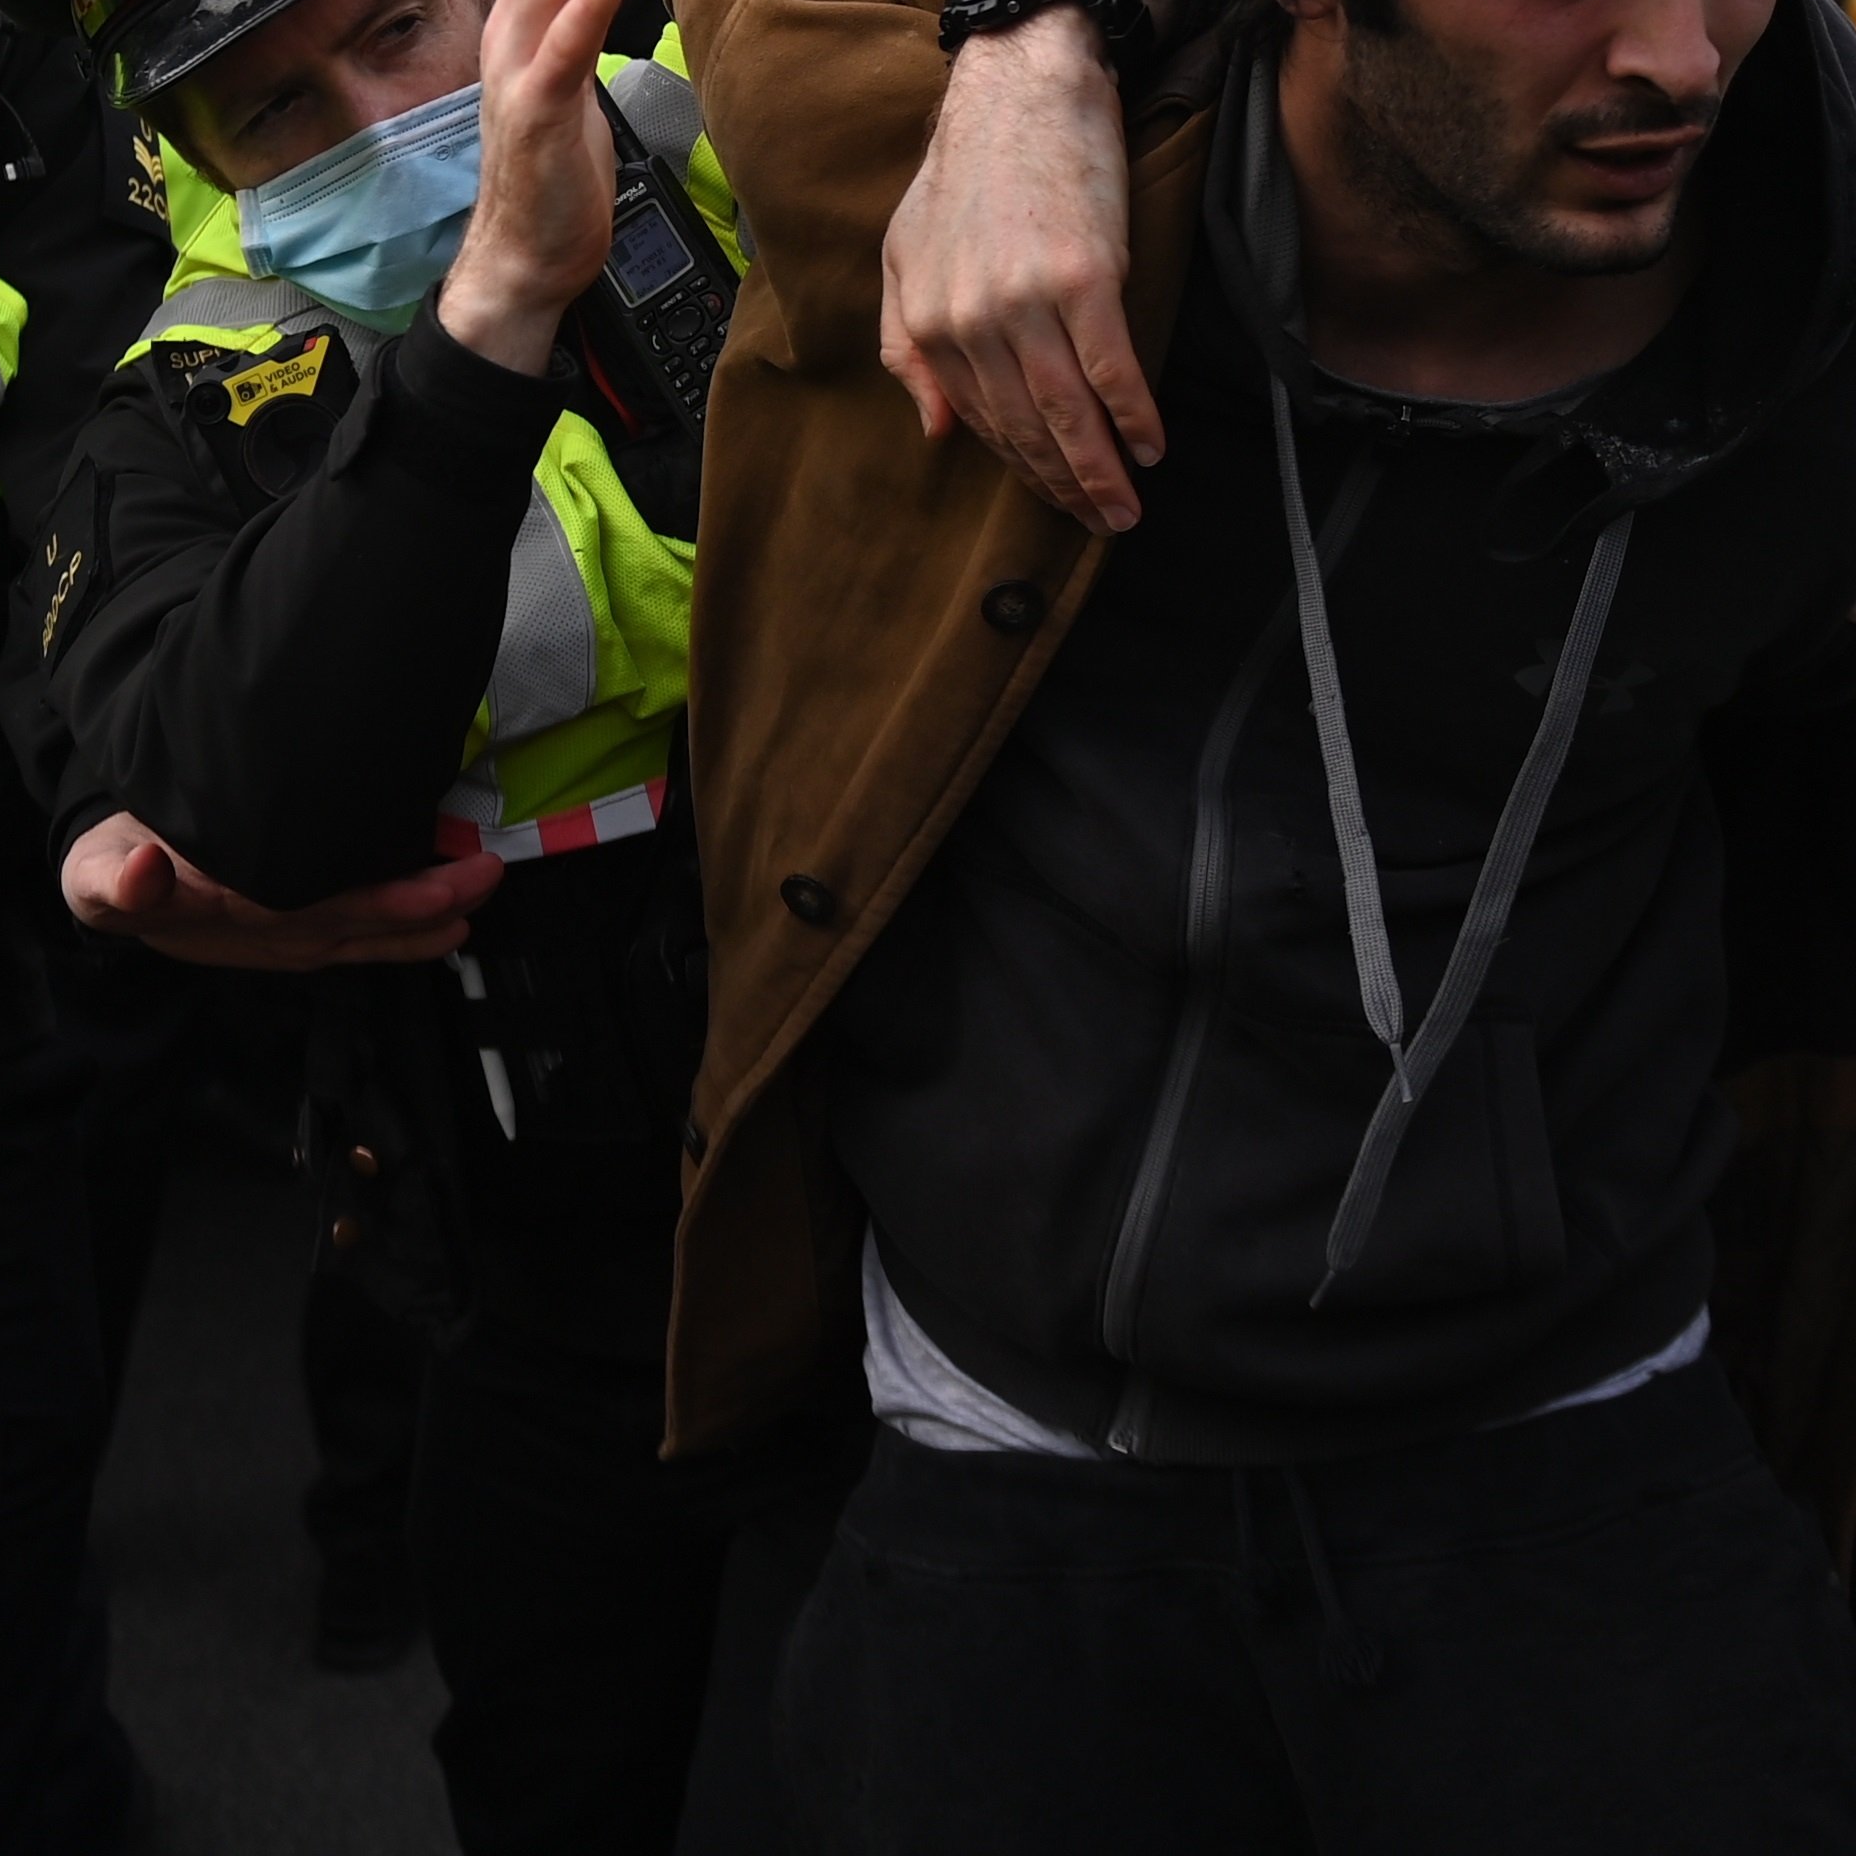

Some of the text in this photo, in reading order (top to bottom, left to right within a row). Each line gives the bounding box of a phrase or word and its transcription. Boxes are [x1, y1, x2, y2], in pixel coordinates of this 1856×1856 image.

[128, 177, 170, 226] 22C
[169, 348, 221, 370] SUP
[264, 361, 301, 383] VIDEO
[269, 366, 317, 394] & AUDIO
[46, 532, 58, 567] U
